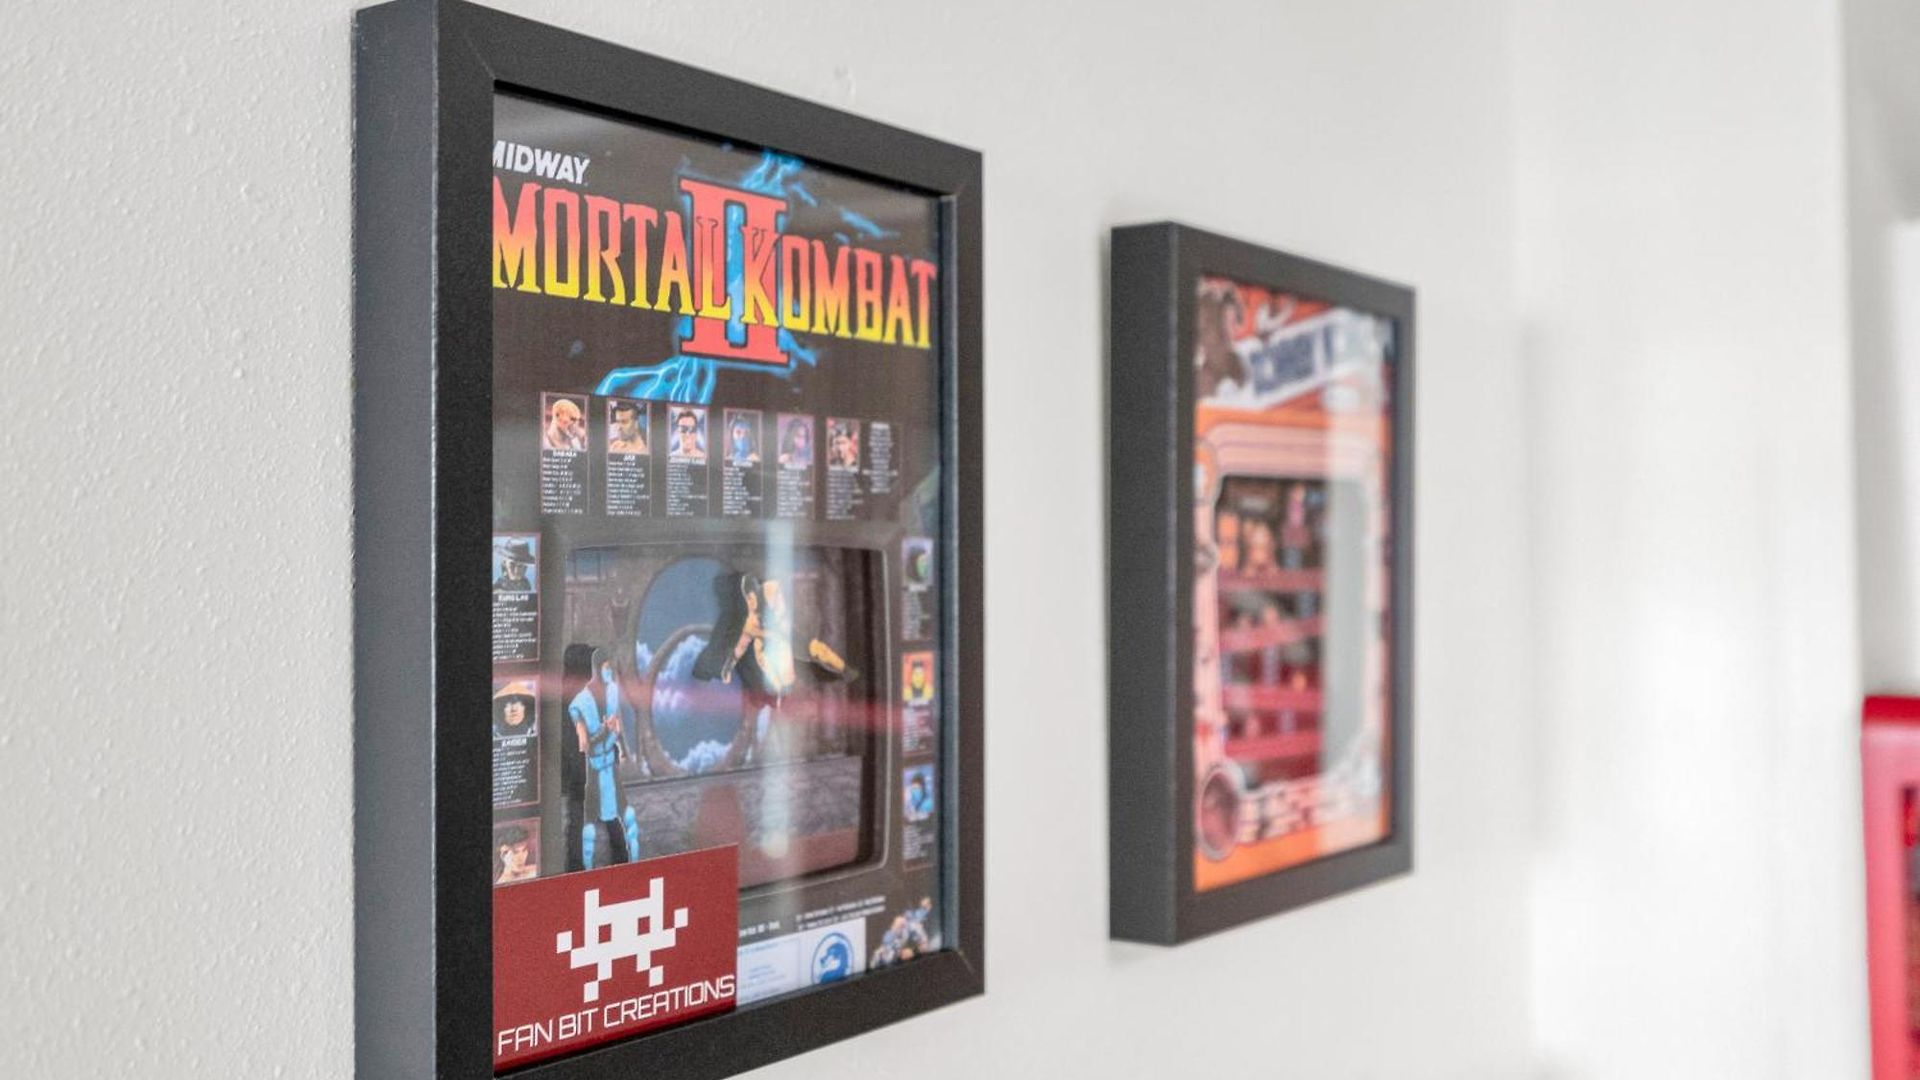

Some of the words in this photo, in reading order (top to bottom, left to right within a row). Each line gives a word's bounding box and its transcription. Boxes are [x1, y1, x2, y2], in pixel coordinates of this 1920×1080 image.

[492, 175, 731, 321] MORTAL
[740, 221, 937, 350] KOMBAT
[497, 1018, 552, 1056] FAN
[558, 1007, 598, 1040] BIT
[603, 974, 736, 1029] CREATIONS
